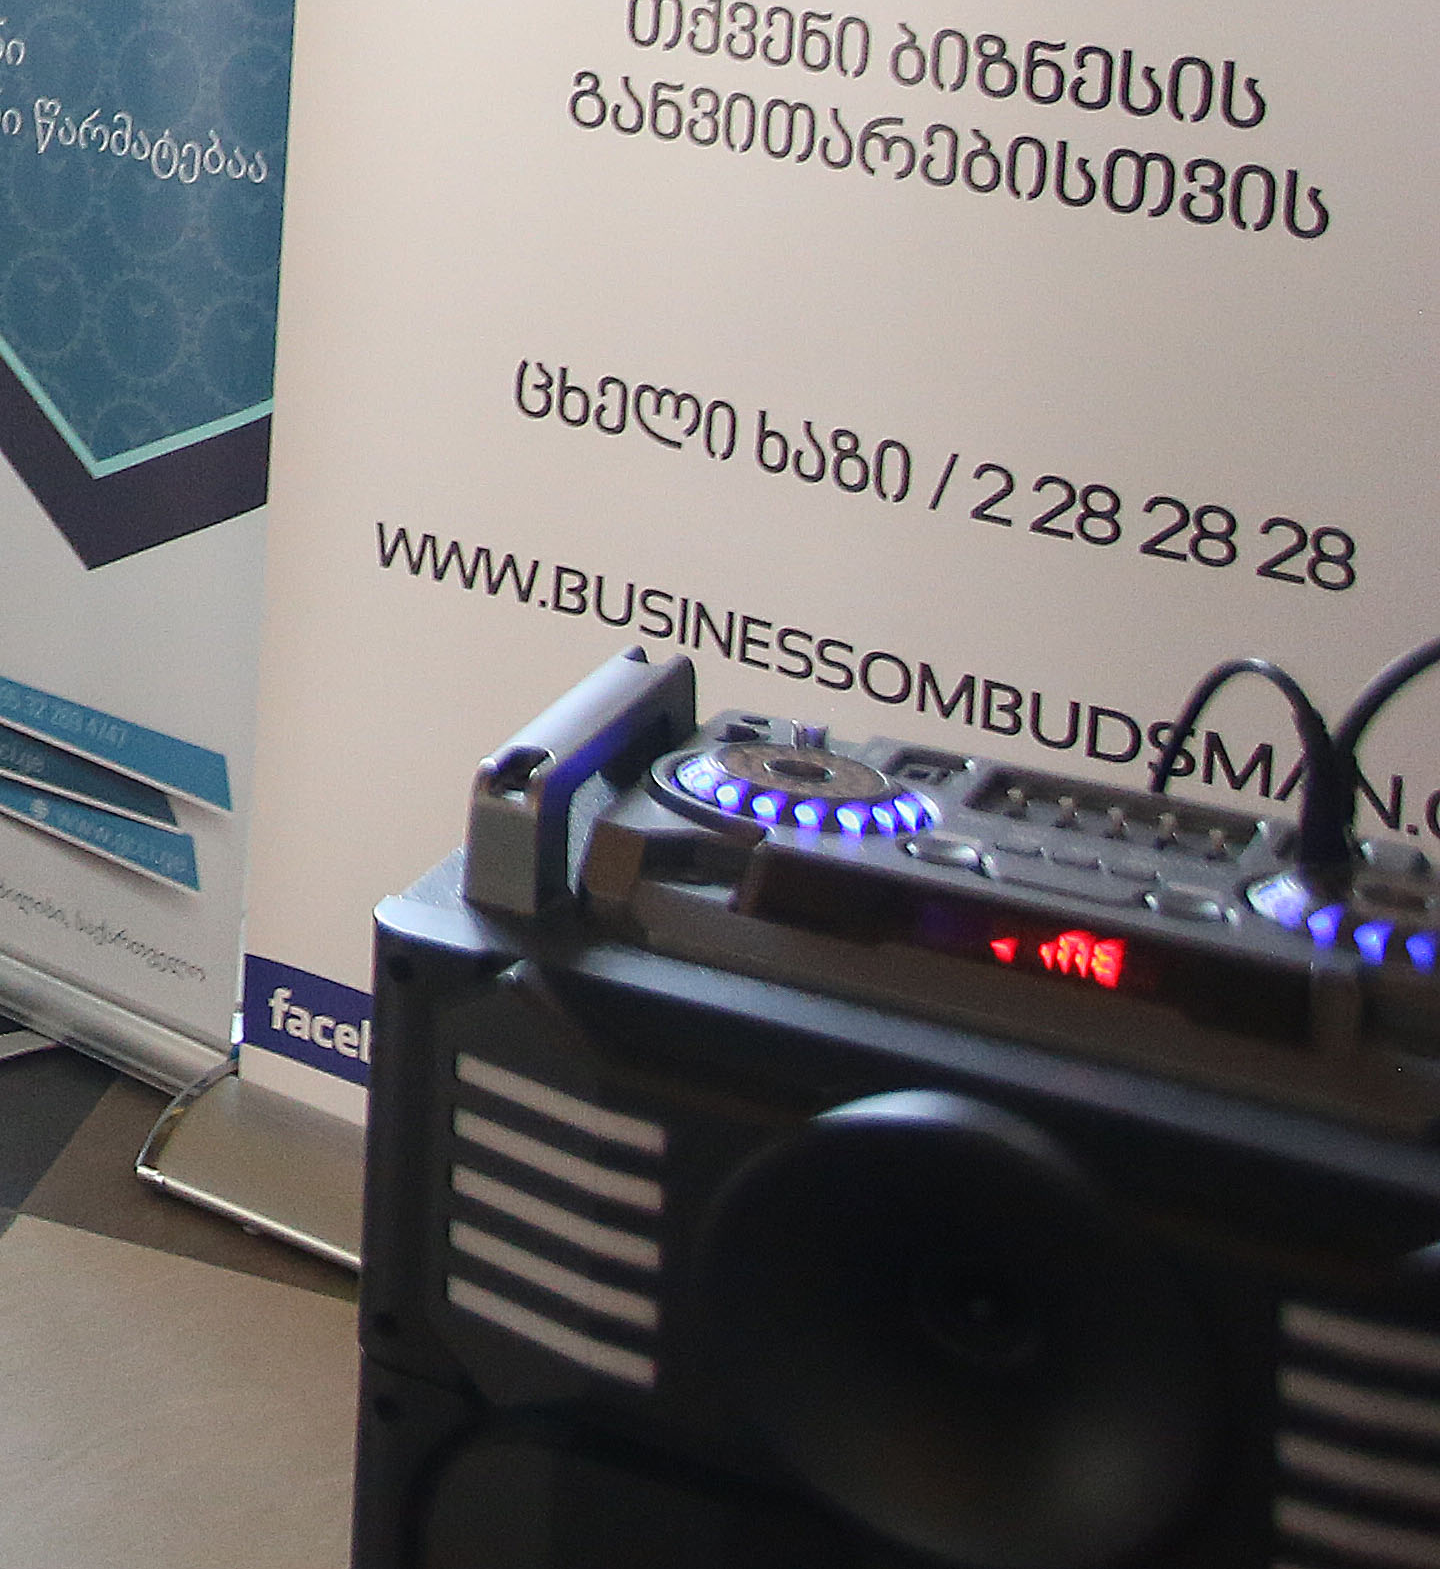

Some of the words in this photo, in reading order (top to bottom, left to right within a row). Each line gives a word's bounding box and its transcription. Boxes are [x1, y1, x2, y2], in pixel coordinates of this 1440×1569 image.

[33, 96, 268, 186] წარმატებაა
[890, 22, 1268, 130] ბიზნესის
[569, 68, 1332, 241] განვითარებისთვის
[513, 357, 737, 462] ცხელი
[755, 408, 912, 503] ხაზი
[929, 452, 960, 512] /
[970, 462, 1015, 527] 2
[1029, 474, 1123, 546] 28
[1139, 494, 1238, 569] 28
[1257, 516, 1358, 592] 28
